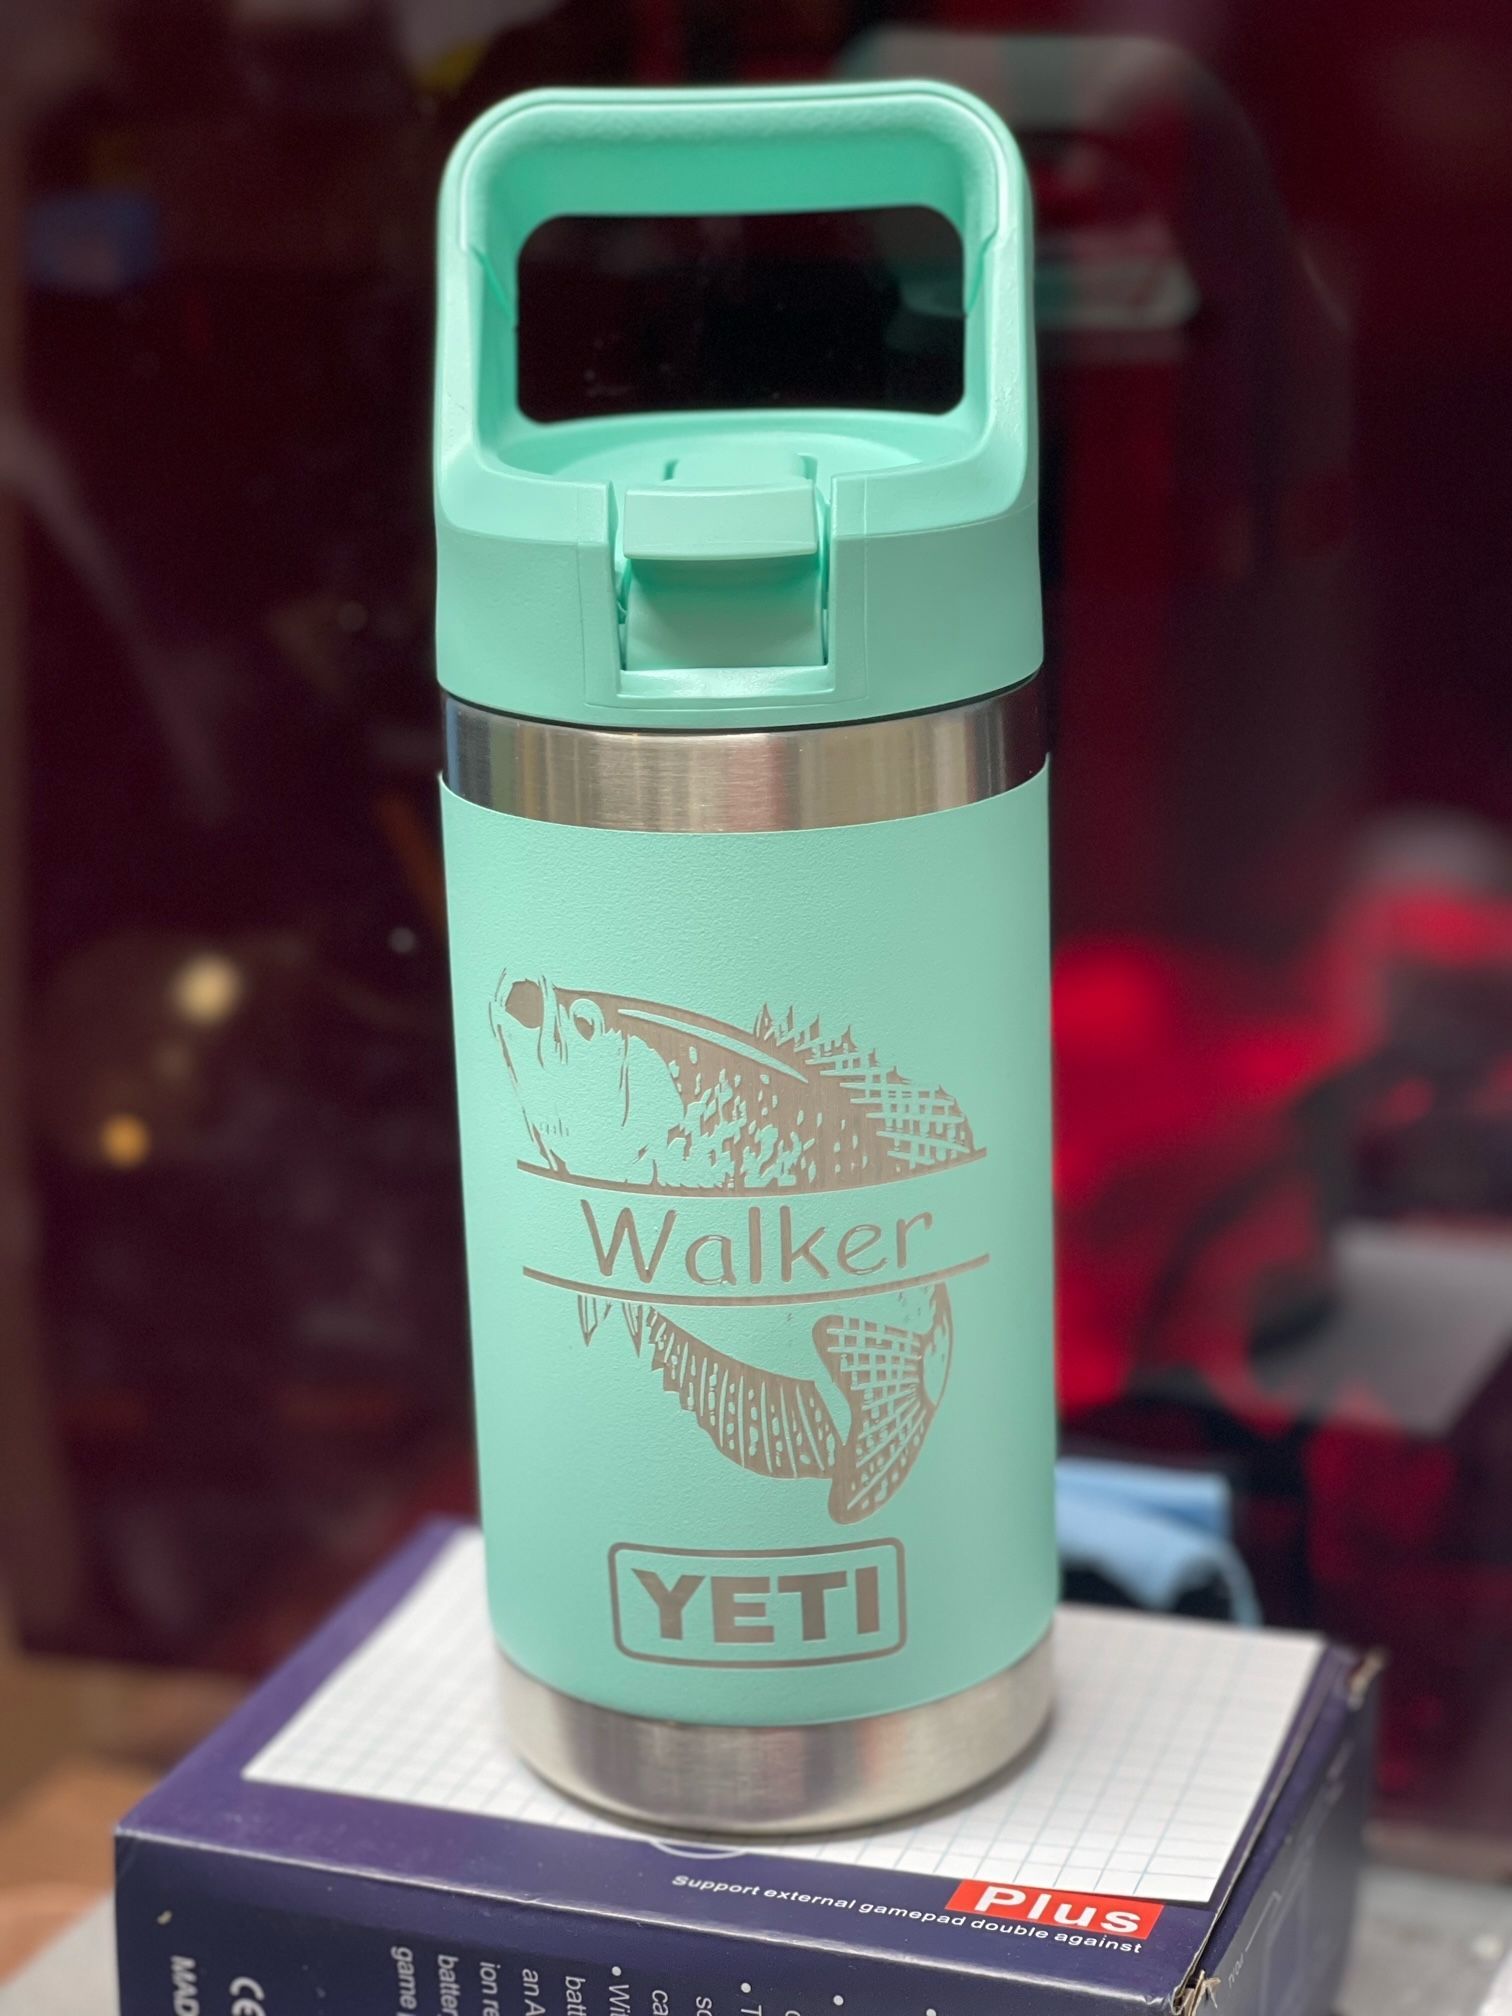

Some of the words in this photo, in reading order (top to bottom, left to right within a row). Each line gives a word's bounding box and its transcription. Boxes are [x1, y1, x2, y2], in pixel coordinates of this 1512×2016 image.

[580, 1199, 932, 1285] Walker
[631, 1566, 880, 1643] YETI
[672, 1875, 760, 1896] Support
[763, 1887, 856, 1909] external
[858, 1902, 966, 1926] gamepad
[970, 1919, 1049, 1938] double
[1054, 1934, 1142, 1953] against
[974, 1885, 1141, 1933] Plus
[390, 1946, 416, 2009] game
[437, 1954, 460, 2016] batter
[479, 1961, 501, 1994] ion
[522, 1968, 540, 1996] an
